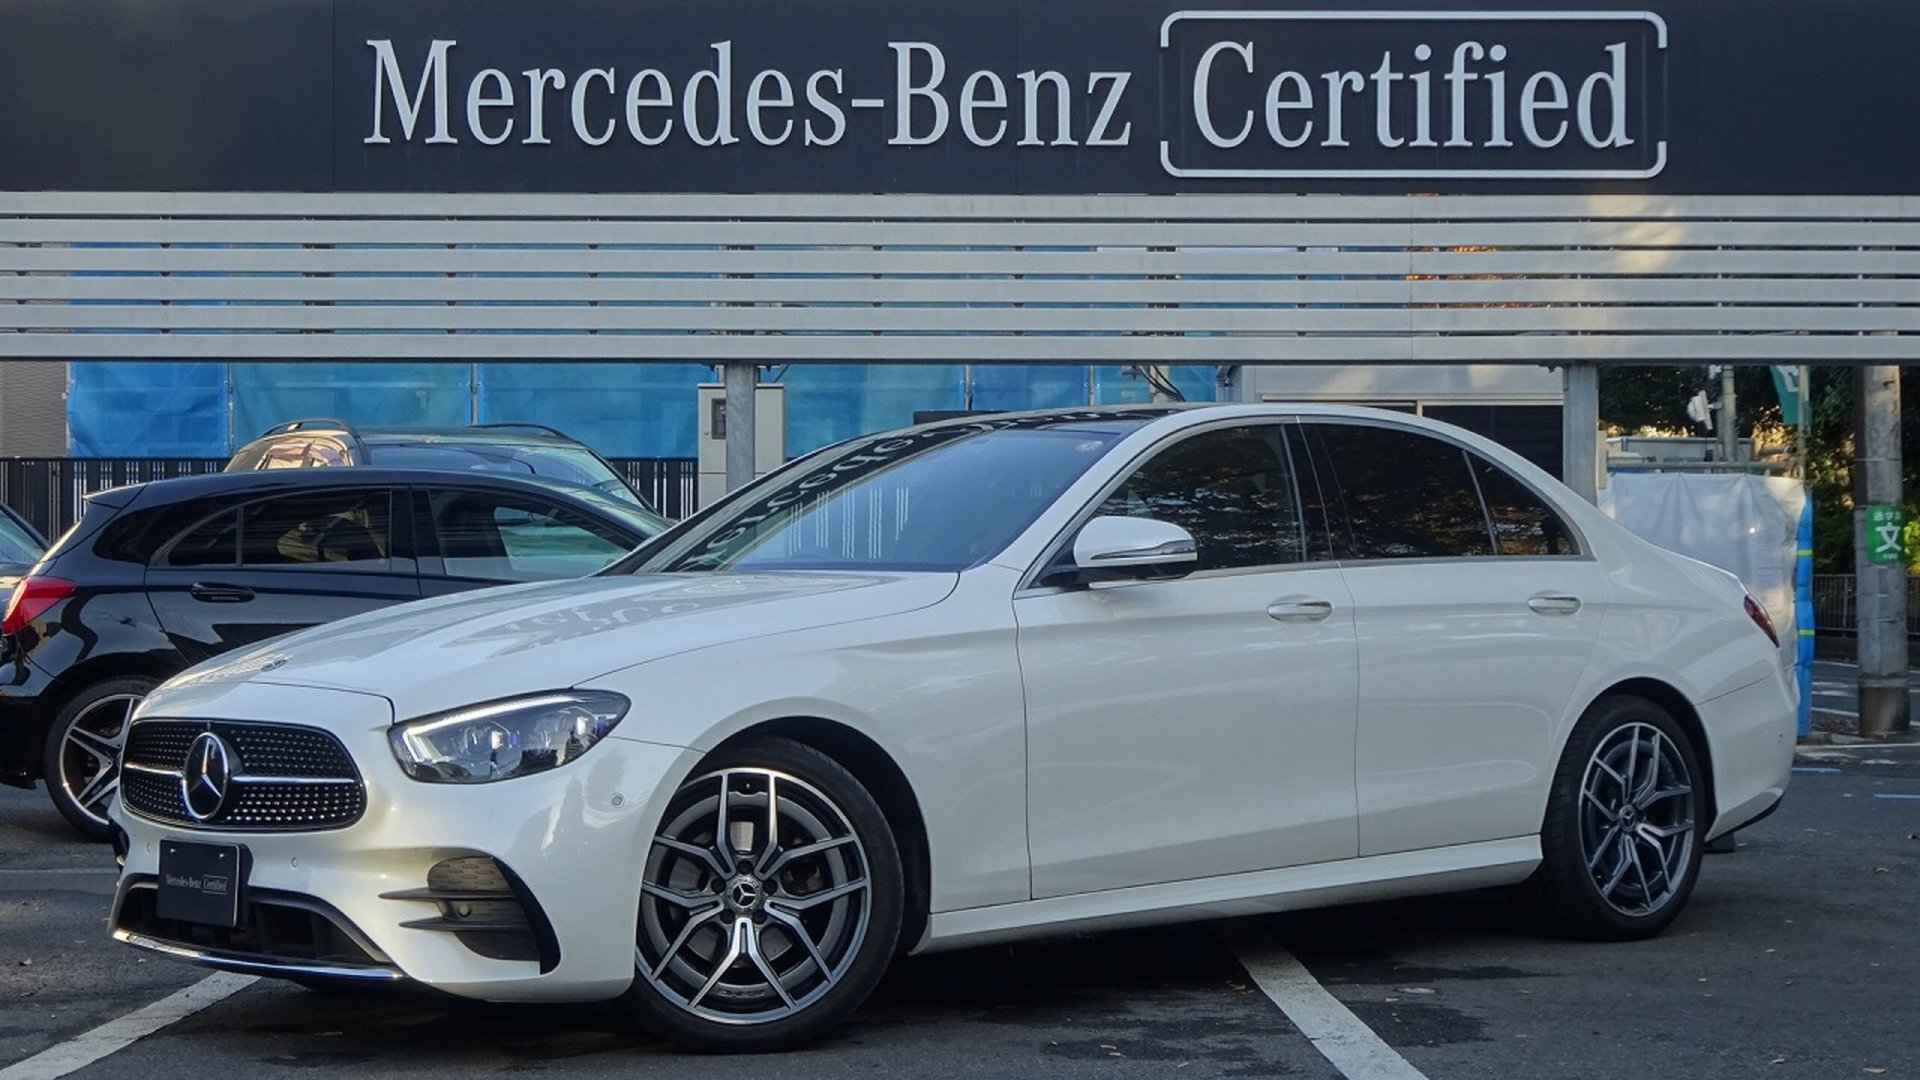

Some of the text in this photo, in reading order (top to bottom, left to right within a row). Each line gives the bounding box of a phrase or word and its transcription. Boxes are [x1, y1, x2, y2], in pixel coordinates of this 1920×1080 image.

[364, 39, 1634, 148] Mercedes-Benz Certified
[1875, 521, 1902, 552] 文
[203, 879, 227, 891] Certified
